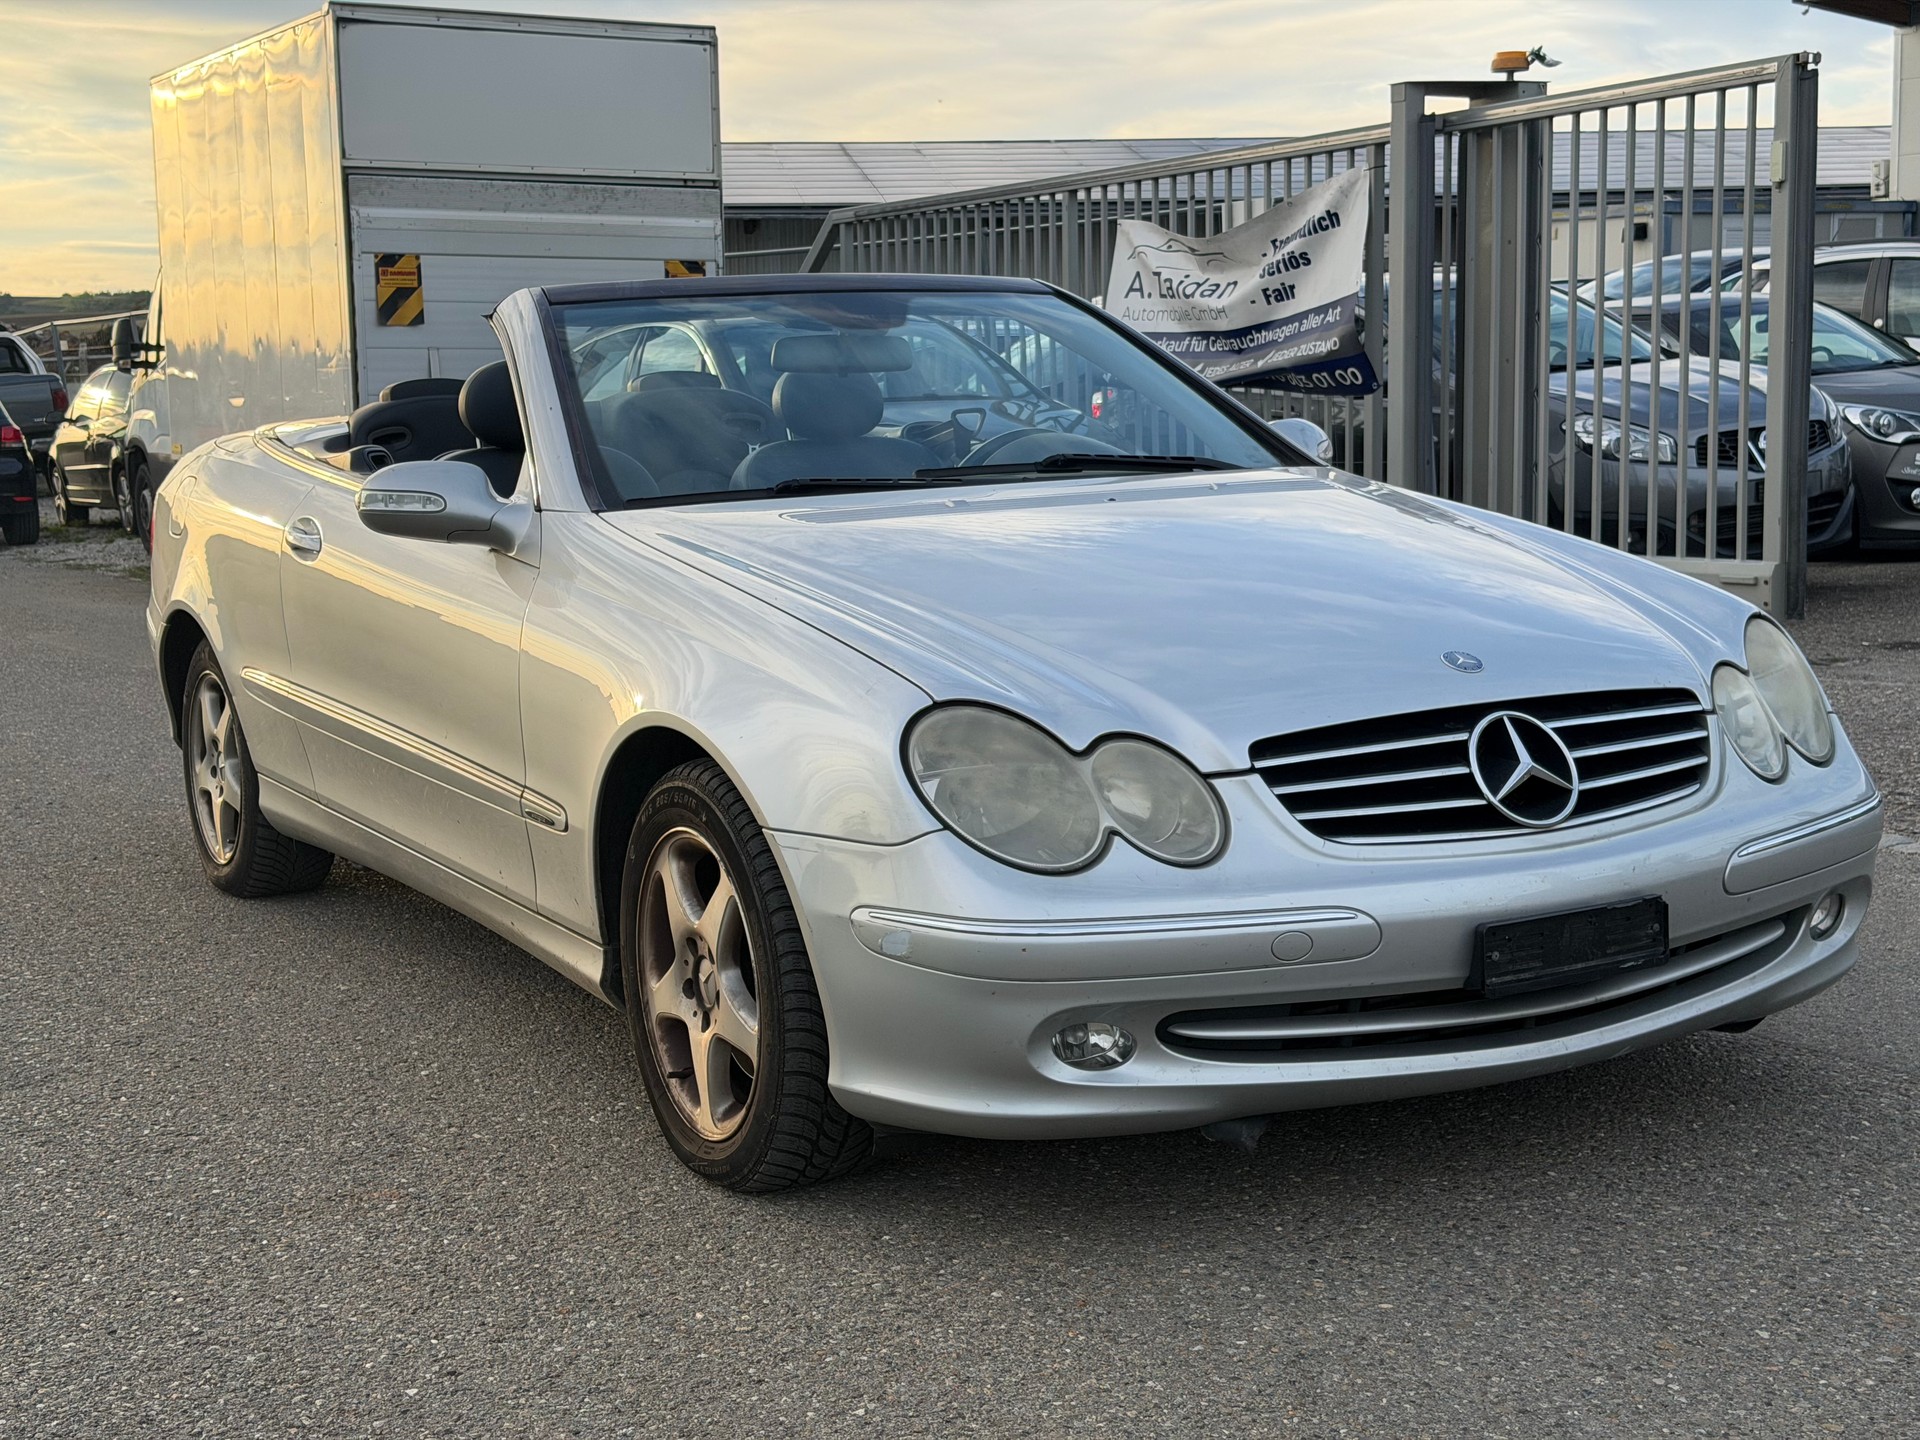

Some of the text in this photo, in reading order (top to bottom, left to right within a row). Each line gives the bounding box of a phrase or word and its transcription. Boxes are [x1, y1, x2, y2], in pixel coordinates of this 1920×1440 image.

[1152, 271, 1239, 300] Zaidan
[1261, 282, 1296, 306] Fair
[1122, 304, 1229, 321] Automobile GmbH
[1189, 336, 1209, 352] für
[1209, 321, 1299, 352] Gebrauchtwagen
[1300, 313, 1325, 332] aller
[1323, 305, 1342, 324] Art
[1296, 337, 1340, 357] ZUSTAND
[1335, 367, 1363, 386] 00
